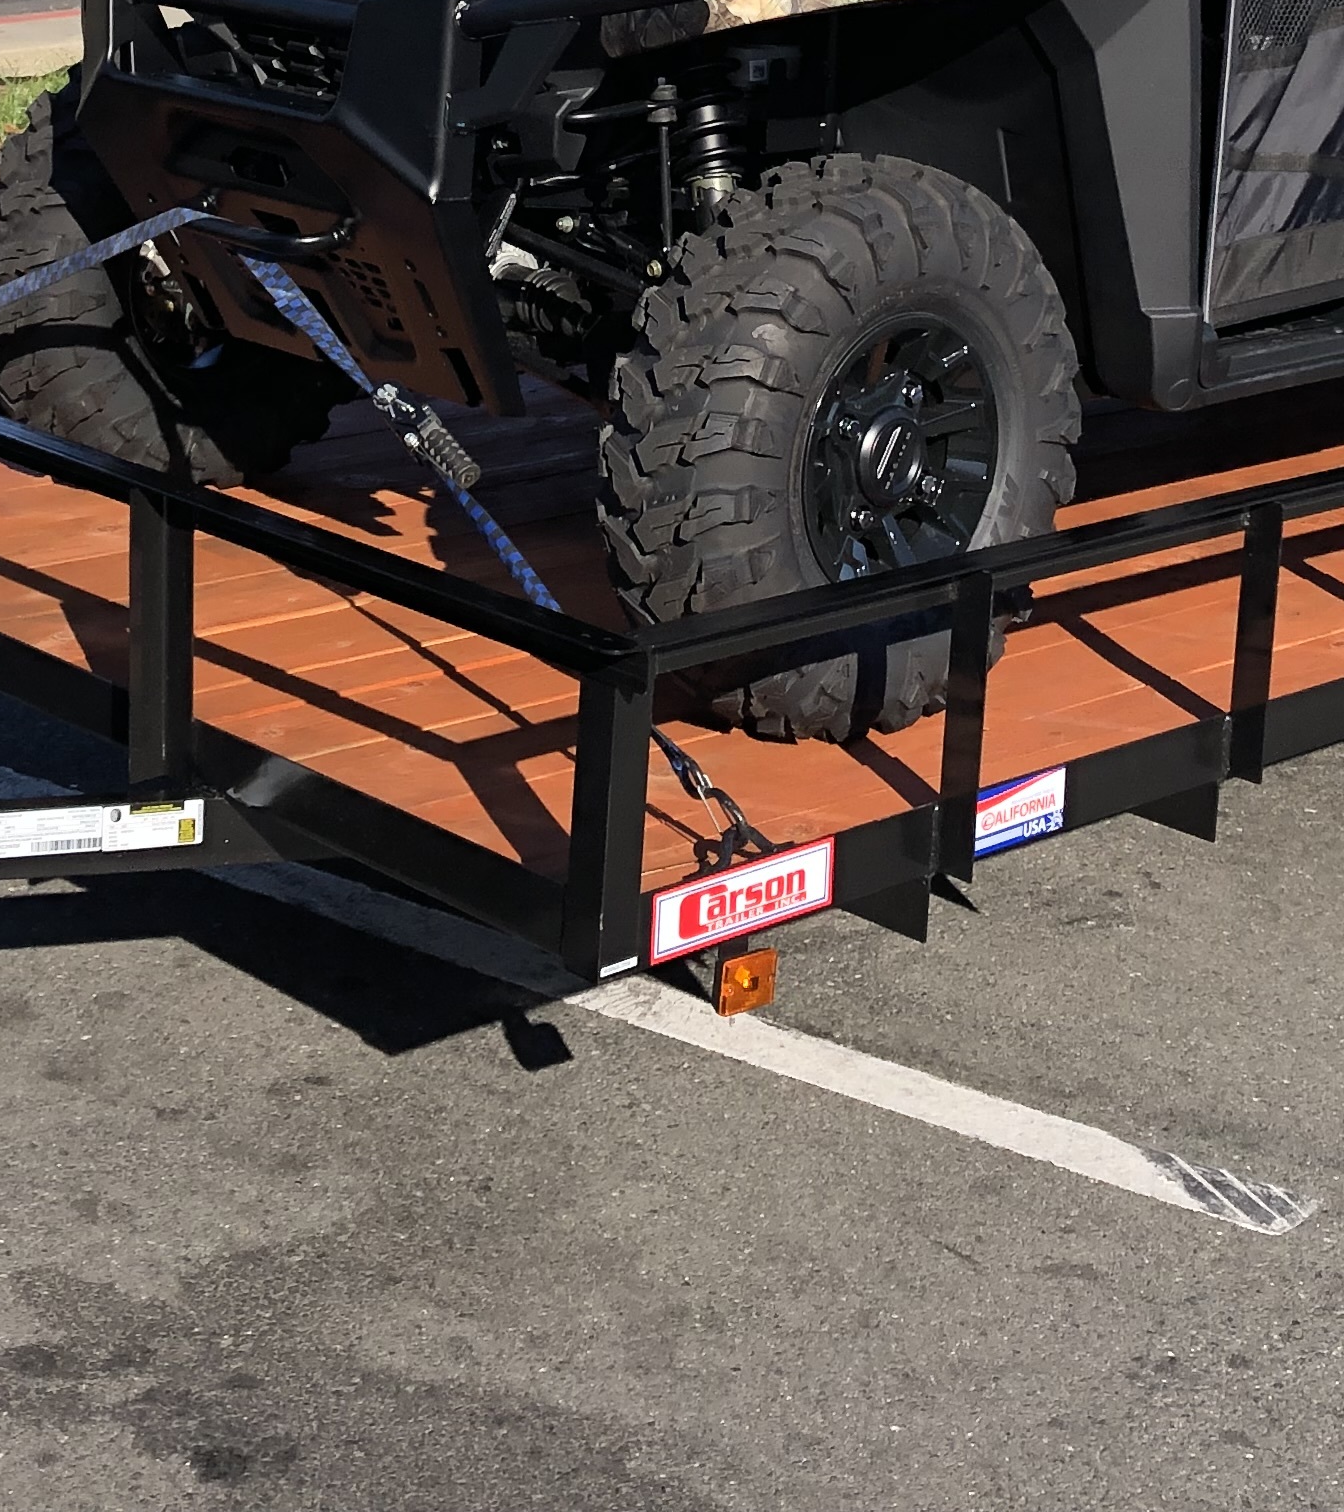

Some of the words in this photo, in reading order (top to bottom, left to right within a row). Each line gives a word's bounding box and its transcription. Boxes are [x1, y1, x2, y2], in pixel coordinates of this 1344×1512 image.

[981, 793, 1056, 831] CALIFORNIA
[1023, 817, 1047, 838] USA
[679, 868, 806, 940] Carson
[706, 906, 764, 932] TRAILER
[774, 892, 805, 910] INC.
